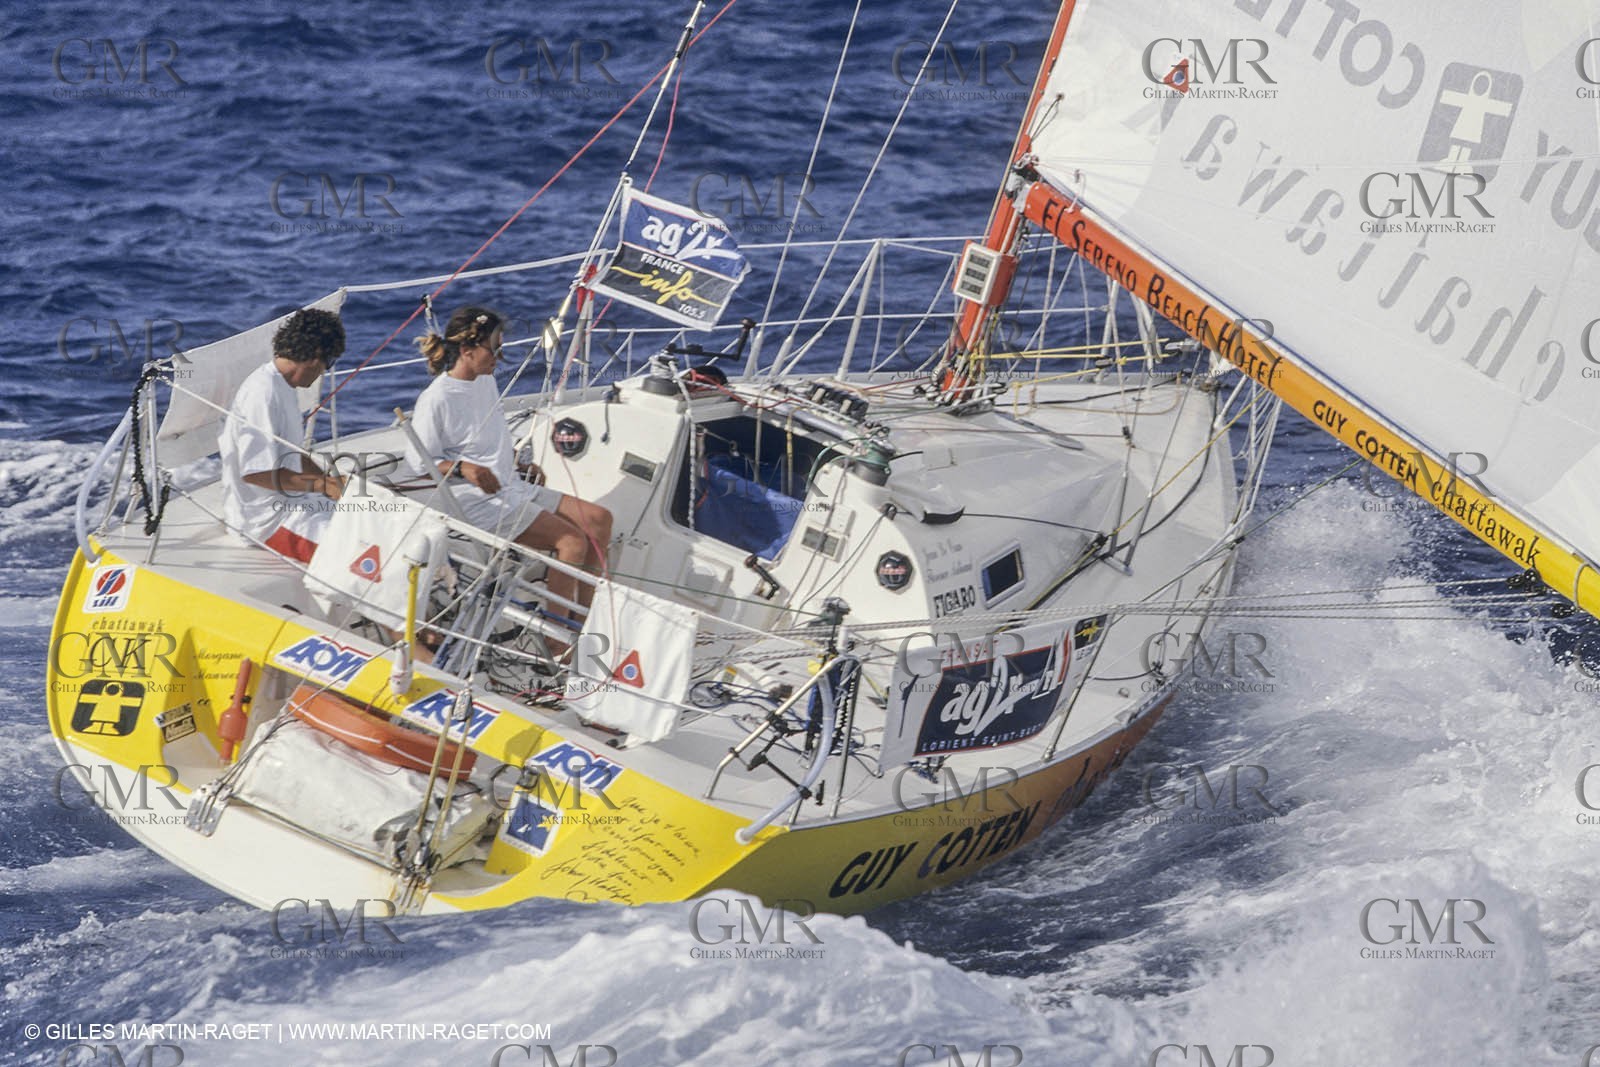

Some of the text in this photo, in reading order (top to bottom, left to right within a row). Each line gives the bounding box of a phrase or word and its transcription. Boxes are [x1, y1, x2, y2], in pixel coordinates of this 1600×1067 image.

[640, 253, 685, 274] FRANCE
[618, 270, 712, 305] info
[1312, 400, 1541, 570] GUY COTTEN chattawak
[280, 638, 368, 682] AOM
[532, 743, 623, 790] AOM
[829, 801, 1041, 899] GUY COTTEN
